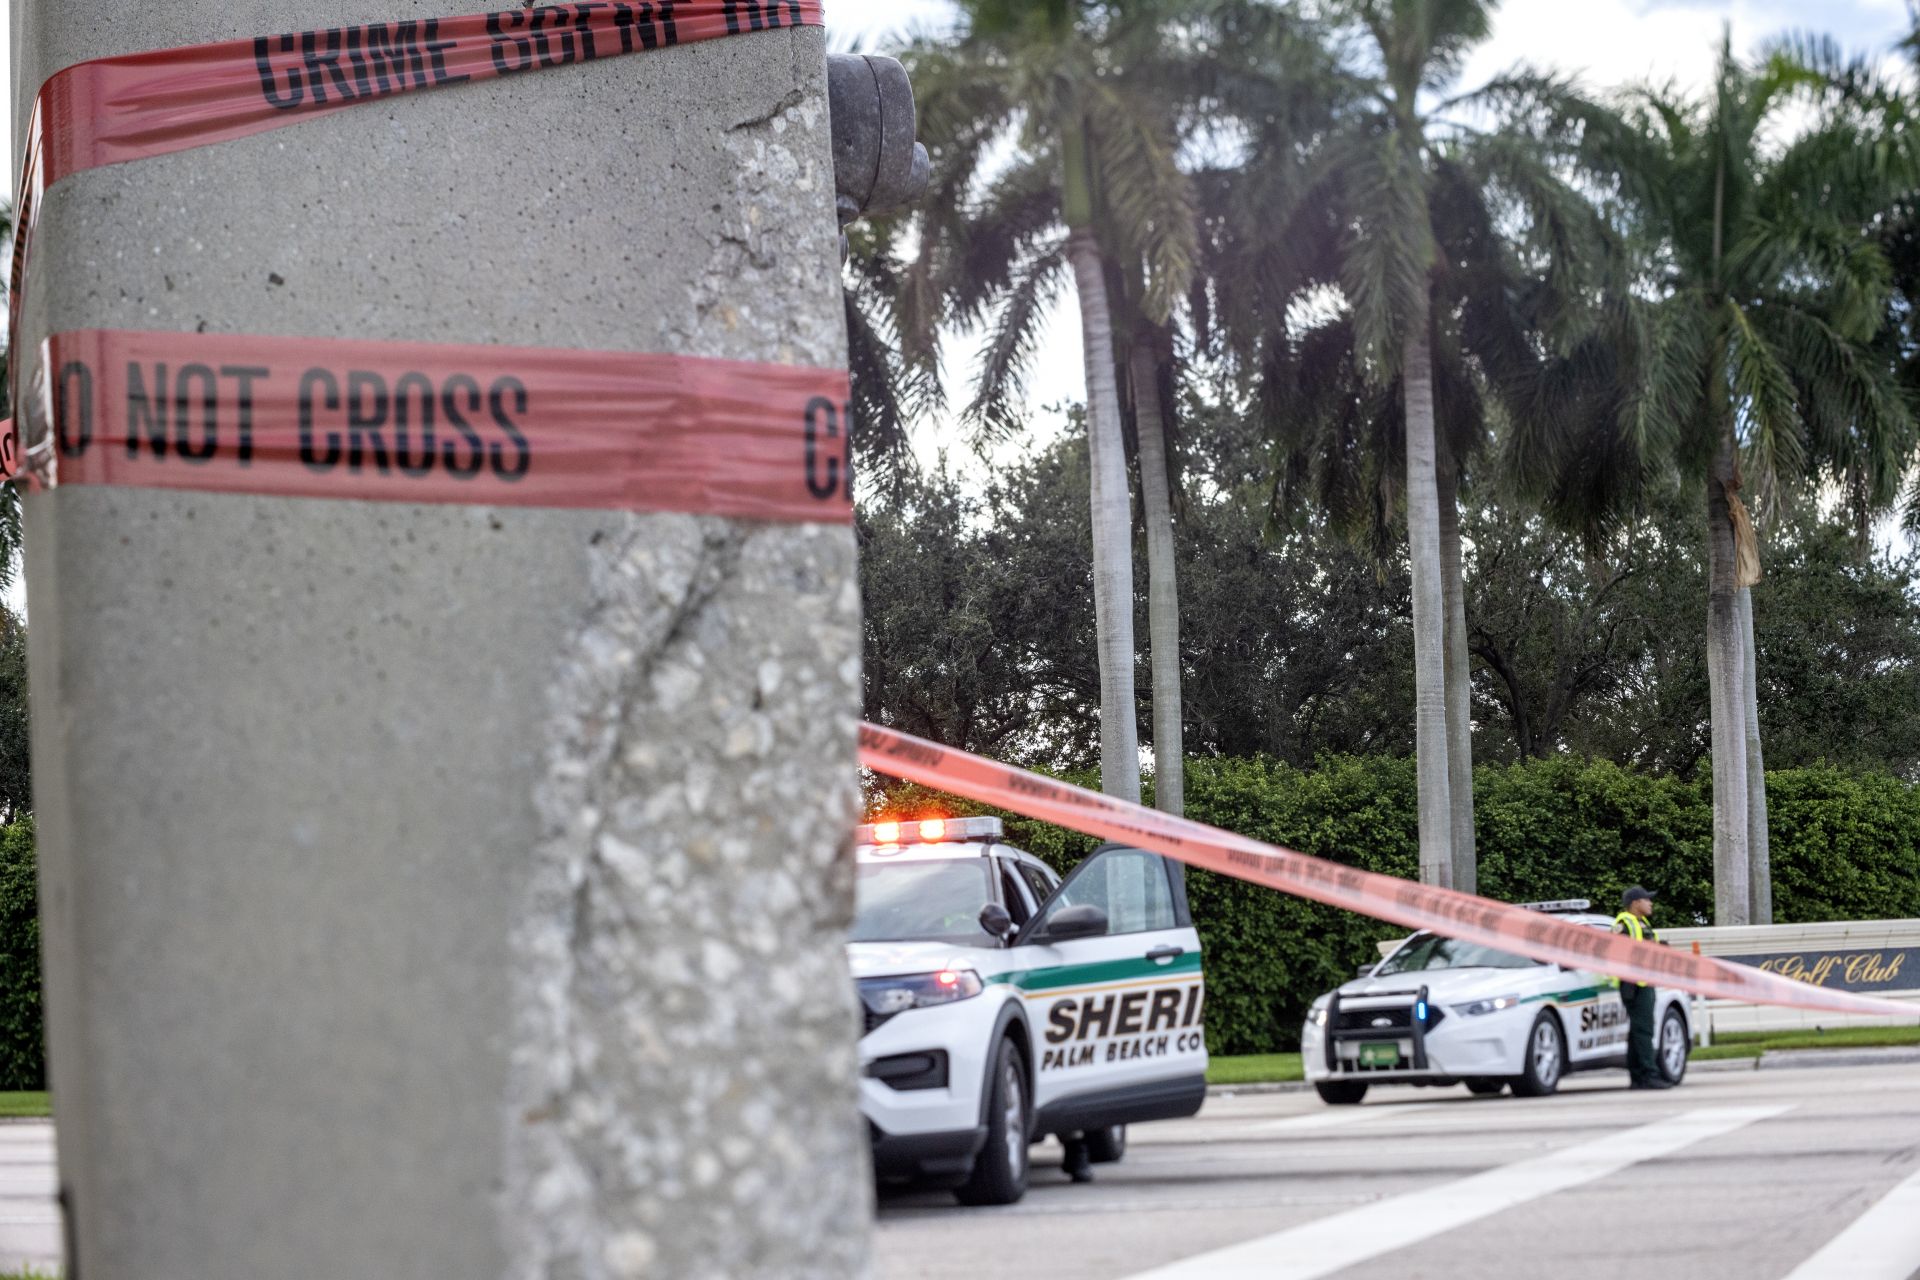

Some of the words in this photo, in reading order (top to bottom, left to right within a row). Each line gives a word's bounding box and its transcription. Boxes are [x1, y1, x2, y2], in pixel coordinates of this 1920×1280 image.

[254, 18, 470, 109] CRIME
[125, 361, 269, 466] NOT
[298, 366, 530, 482] CROSS
[804, 396, 853, 502] C
[1774, 955, 1841, 987] Golf
[1844, 952, 1905, 983] Club
[1045, 985, 1204, 1044] SHERI
[1041, 1045, 1095, 1071] PALM
[1106, 1035, 1168, 1063] BEACH
[1176, 1032, 1200, 1051] CO
